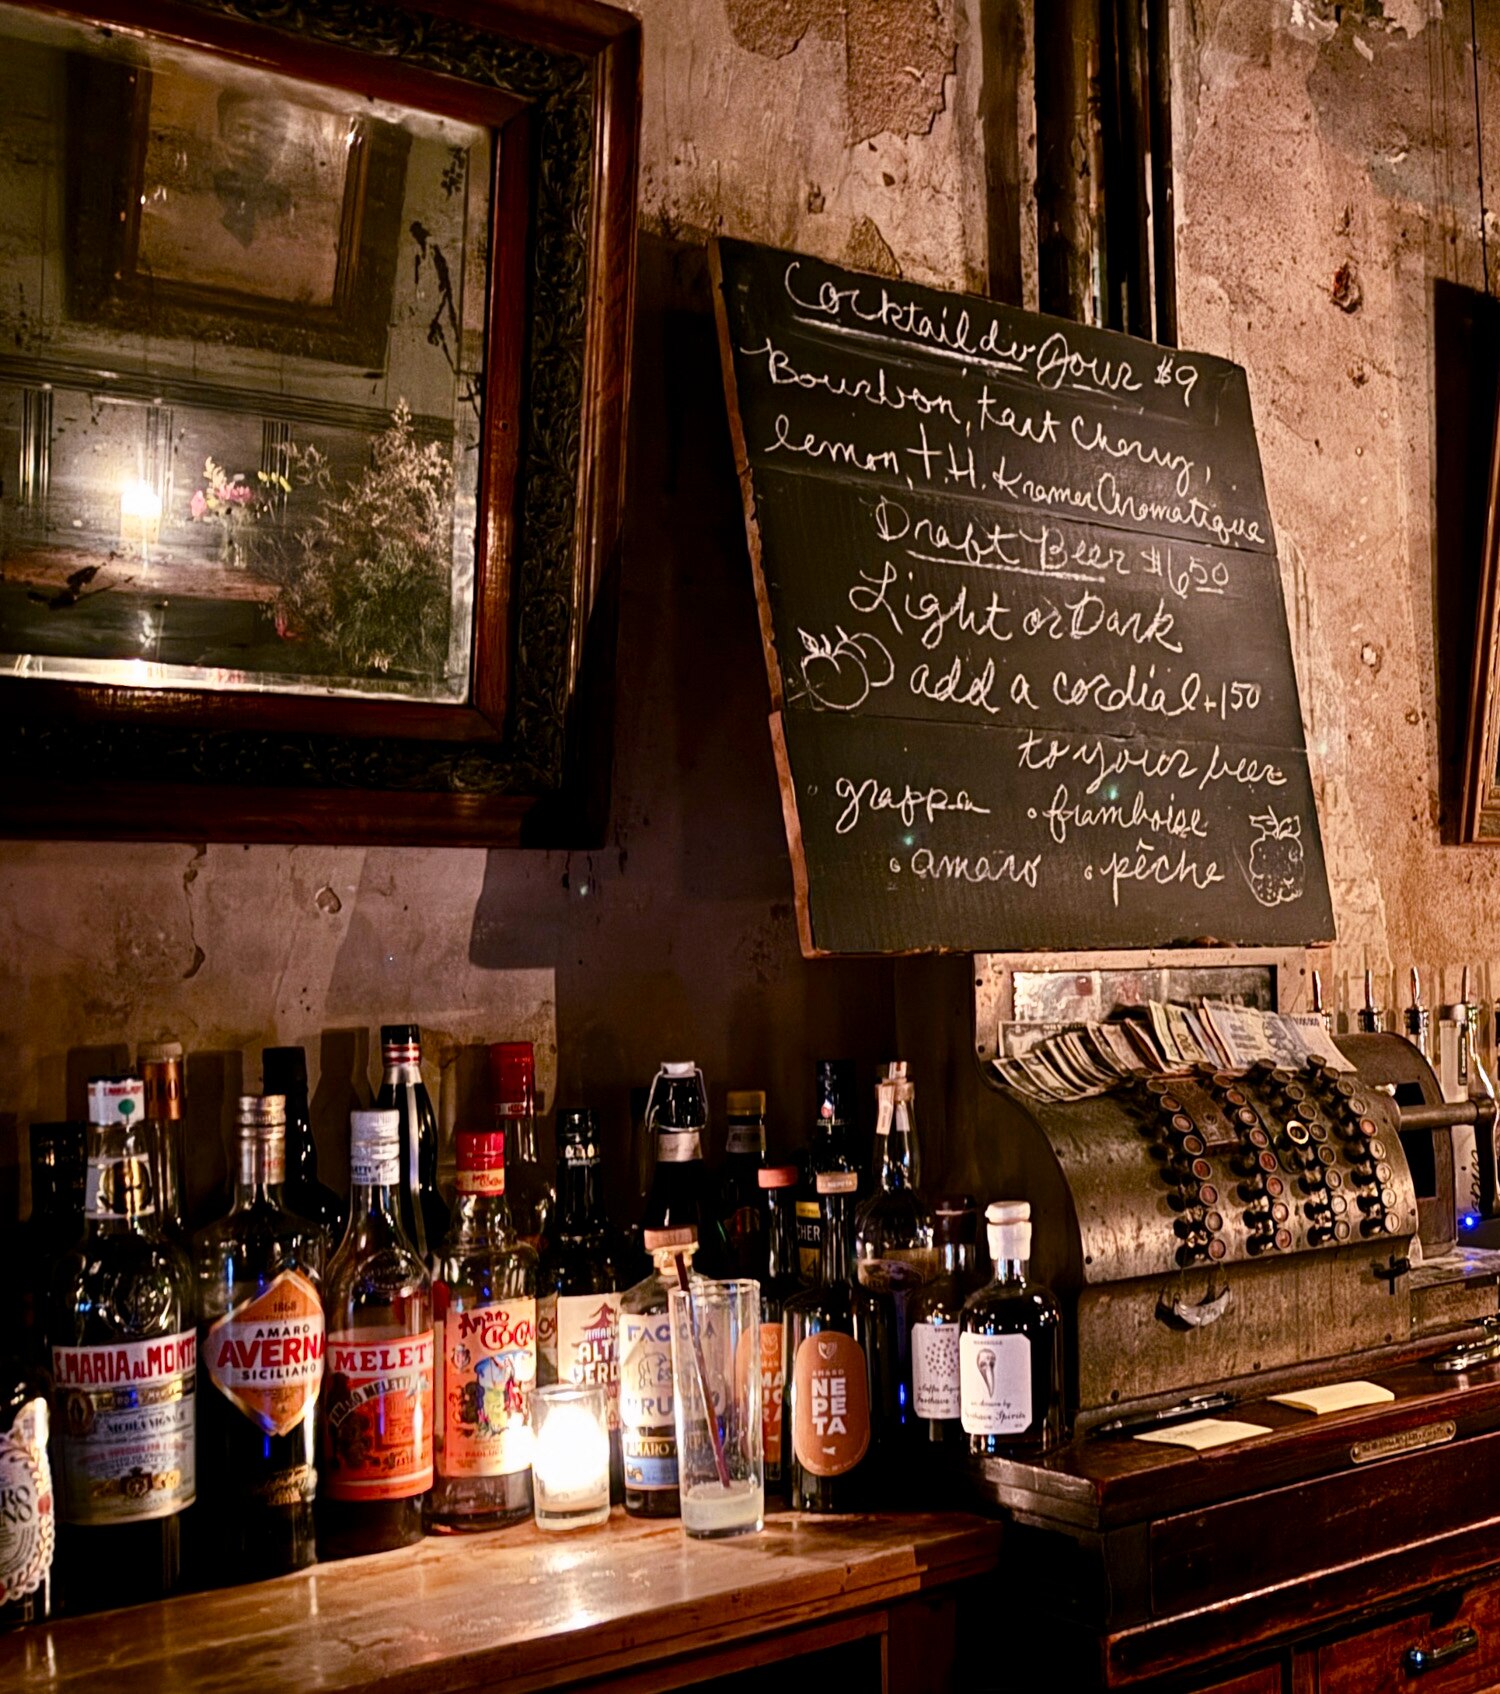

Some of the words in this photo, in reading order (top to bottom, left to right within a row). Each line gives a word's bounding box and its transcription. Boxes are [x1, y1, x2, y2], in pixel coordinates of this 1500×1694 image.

[785, 262, 976, 353] Cocktail
[1153, 355, 1199, 407] $9
[977, 384, 1061, 444] tart
[874, 494, 1020, 565] Draft
[1018, 525, 1131, 571] Beer
[848, 560, 1013, 649] Light
[1022, 604, 1064, 640] or
[1064, 593, 1182, 653] Dark
[910, 656, 999, 714] add
[1010, 673, 1039, 710] a
[1051, 663, 1202, 717] cordial
[1018, 728, 1070, 771] to
[1072, 741, 1198, 794] your
[911, 848, 1043, 888] amaro
[216, 1329, 326, 1369] AVERNA
[254, 1323, 311, 1339] AMARO
[241, 1362, 317, 1381] SICILIANO
